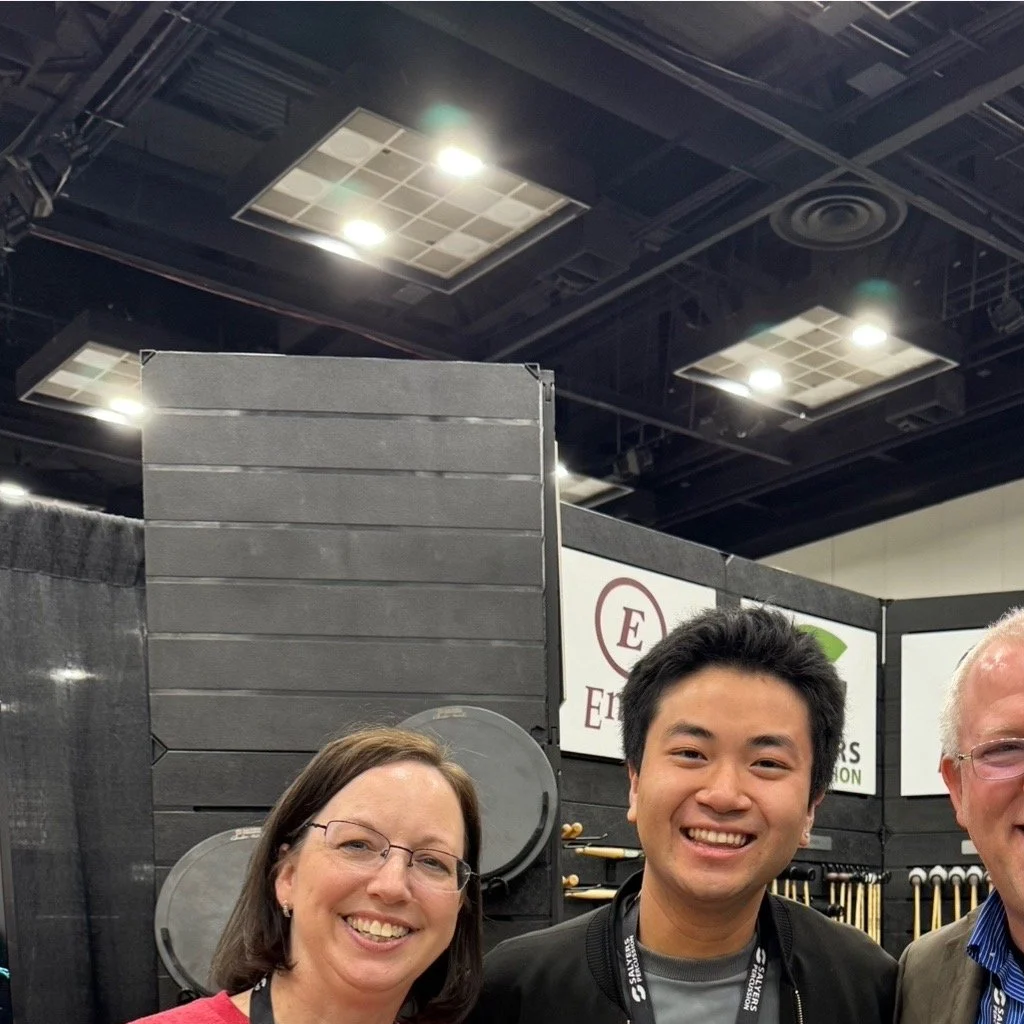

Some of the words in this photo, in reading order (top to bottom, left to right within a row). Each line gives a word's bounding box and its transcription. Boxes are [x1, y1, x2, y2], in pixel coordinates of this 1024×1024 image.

[616, 606, 645, 652] E
[624, 937, 637, 985] SALYERS
[743, 963, 760, 1011] PERCUSSION
[750, 964, 765, 1012] SALYERS
